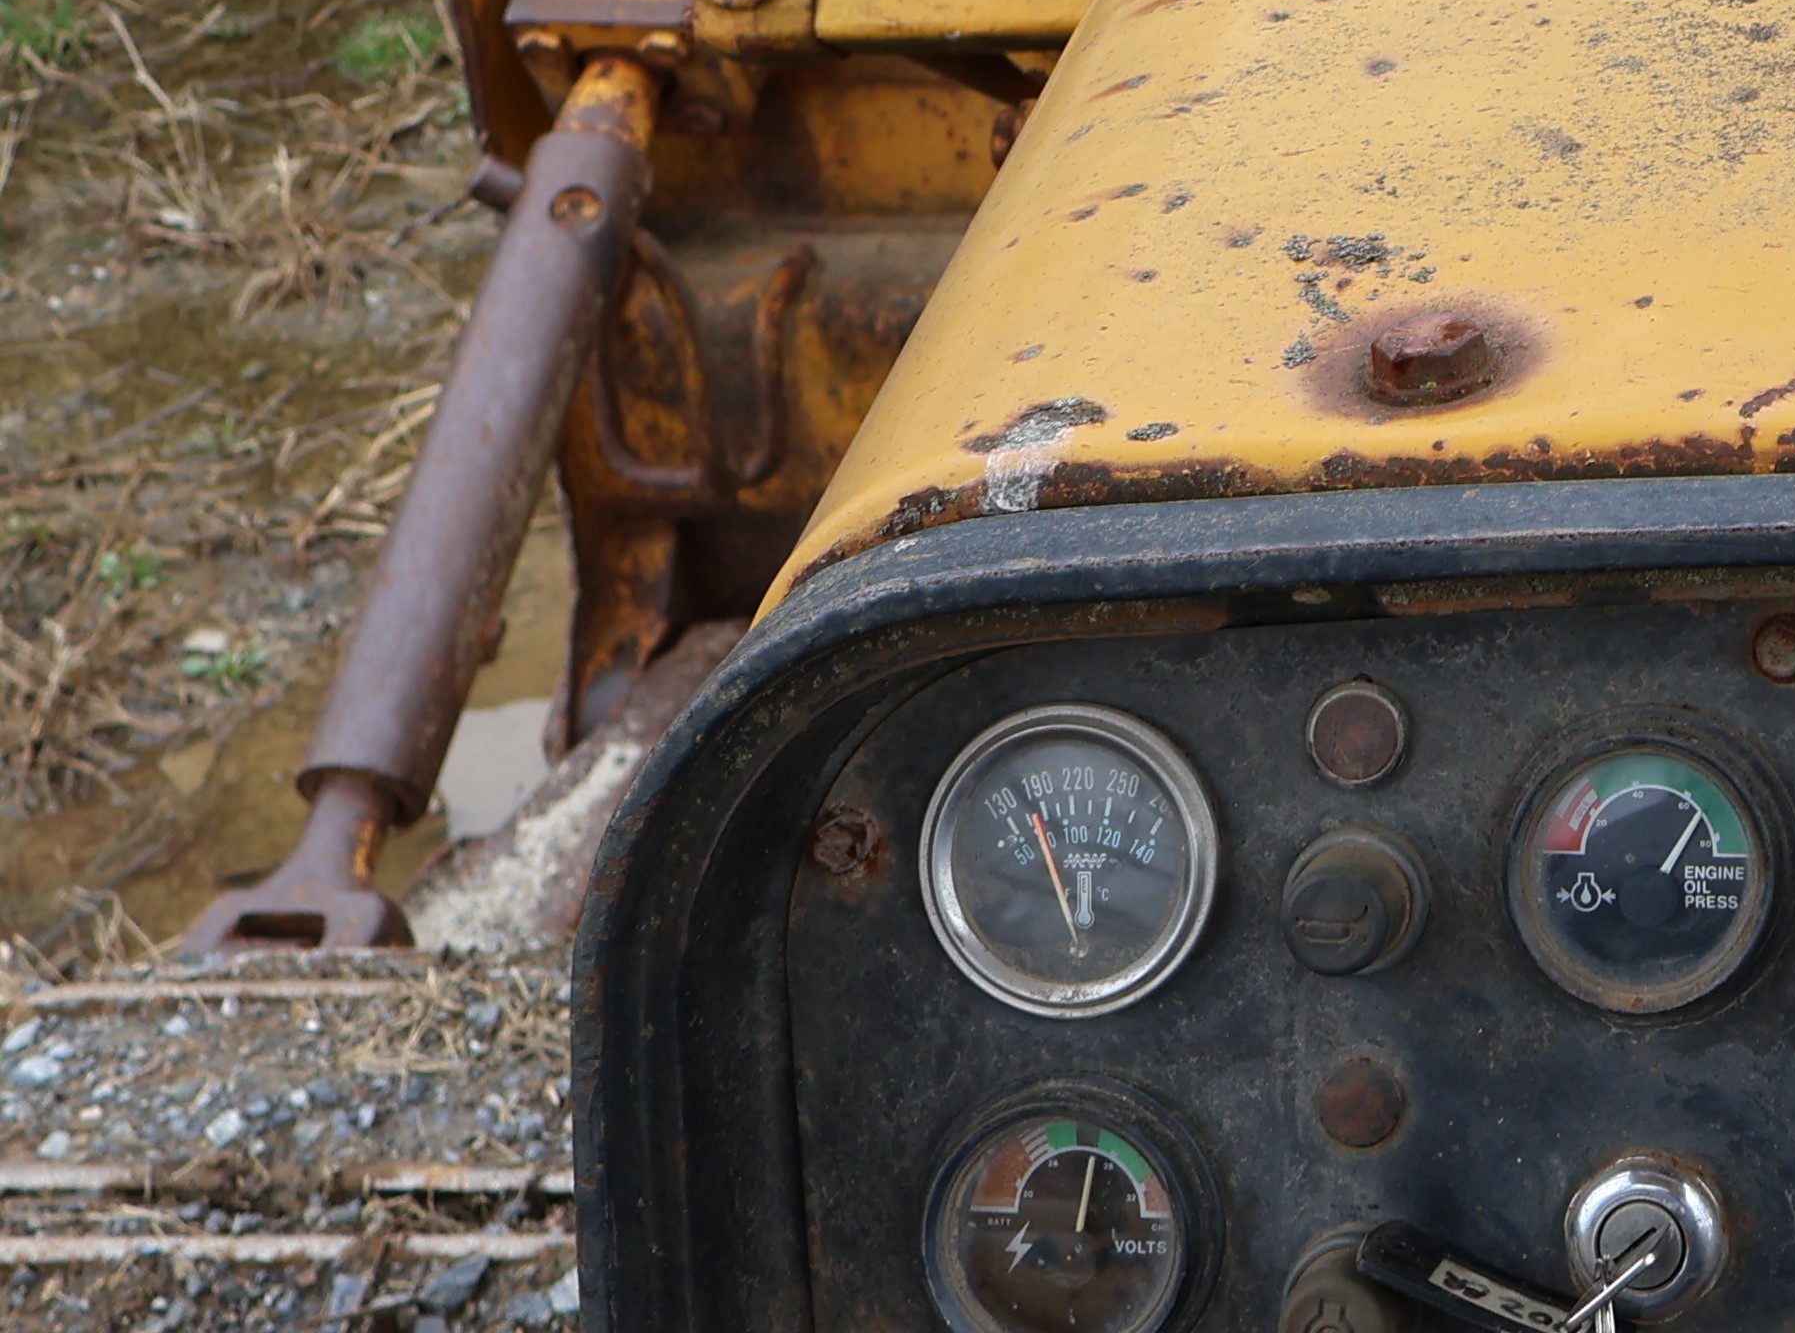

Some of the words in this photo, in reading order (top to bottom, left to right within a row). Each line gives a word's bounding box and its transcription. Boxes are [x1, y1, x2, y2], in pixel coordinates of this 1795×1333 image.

[984, 787, 1017, 820] 130
[1021, 771, 1054, 800] 190
[1062, 767, 1094, 791] 220
[1106, 769, 1140, 798] 250
[1632, 790, 1644, 799] 40
[1678, 802, 1690, 811] 60
[1596, 819, 1608, 827] 20
[1014, 844, 1036, 866] 50
[1063, 825, 1089, 845] 100
[1097, 826, 1122, 849] 120
[1129, 839, 1155, 865] 140
[1700, 840, 1712, 848] 80
[1684, 866, 1745, 880] ENGINE
[1684, 881, 1711, 894] OIL
[1685, 895, 1739, 909] PRESS
[988, 1216, 1012, 1227] BATT
[1114, 1239, 1167, 1255] VOLTS
